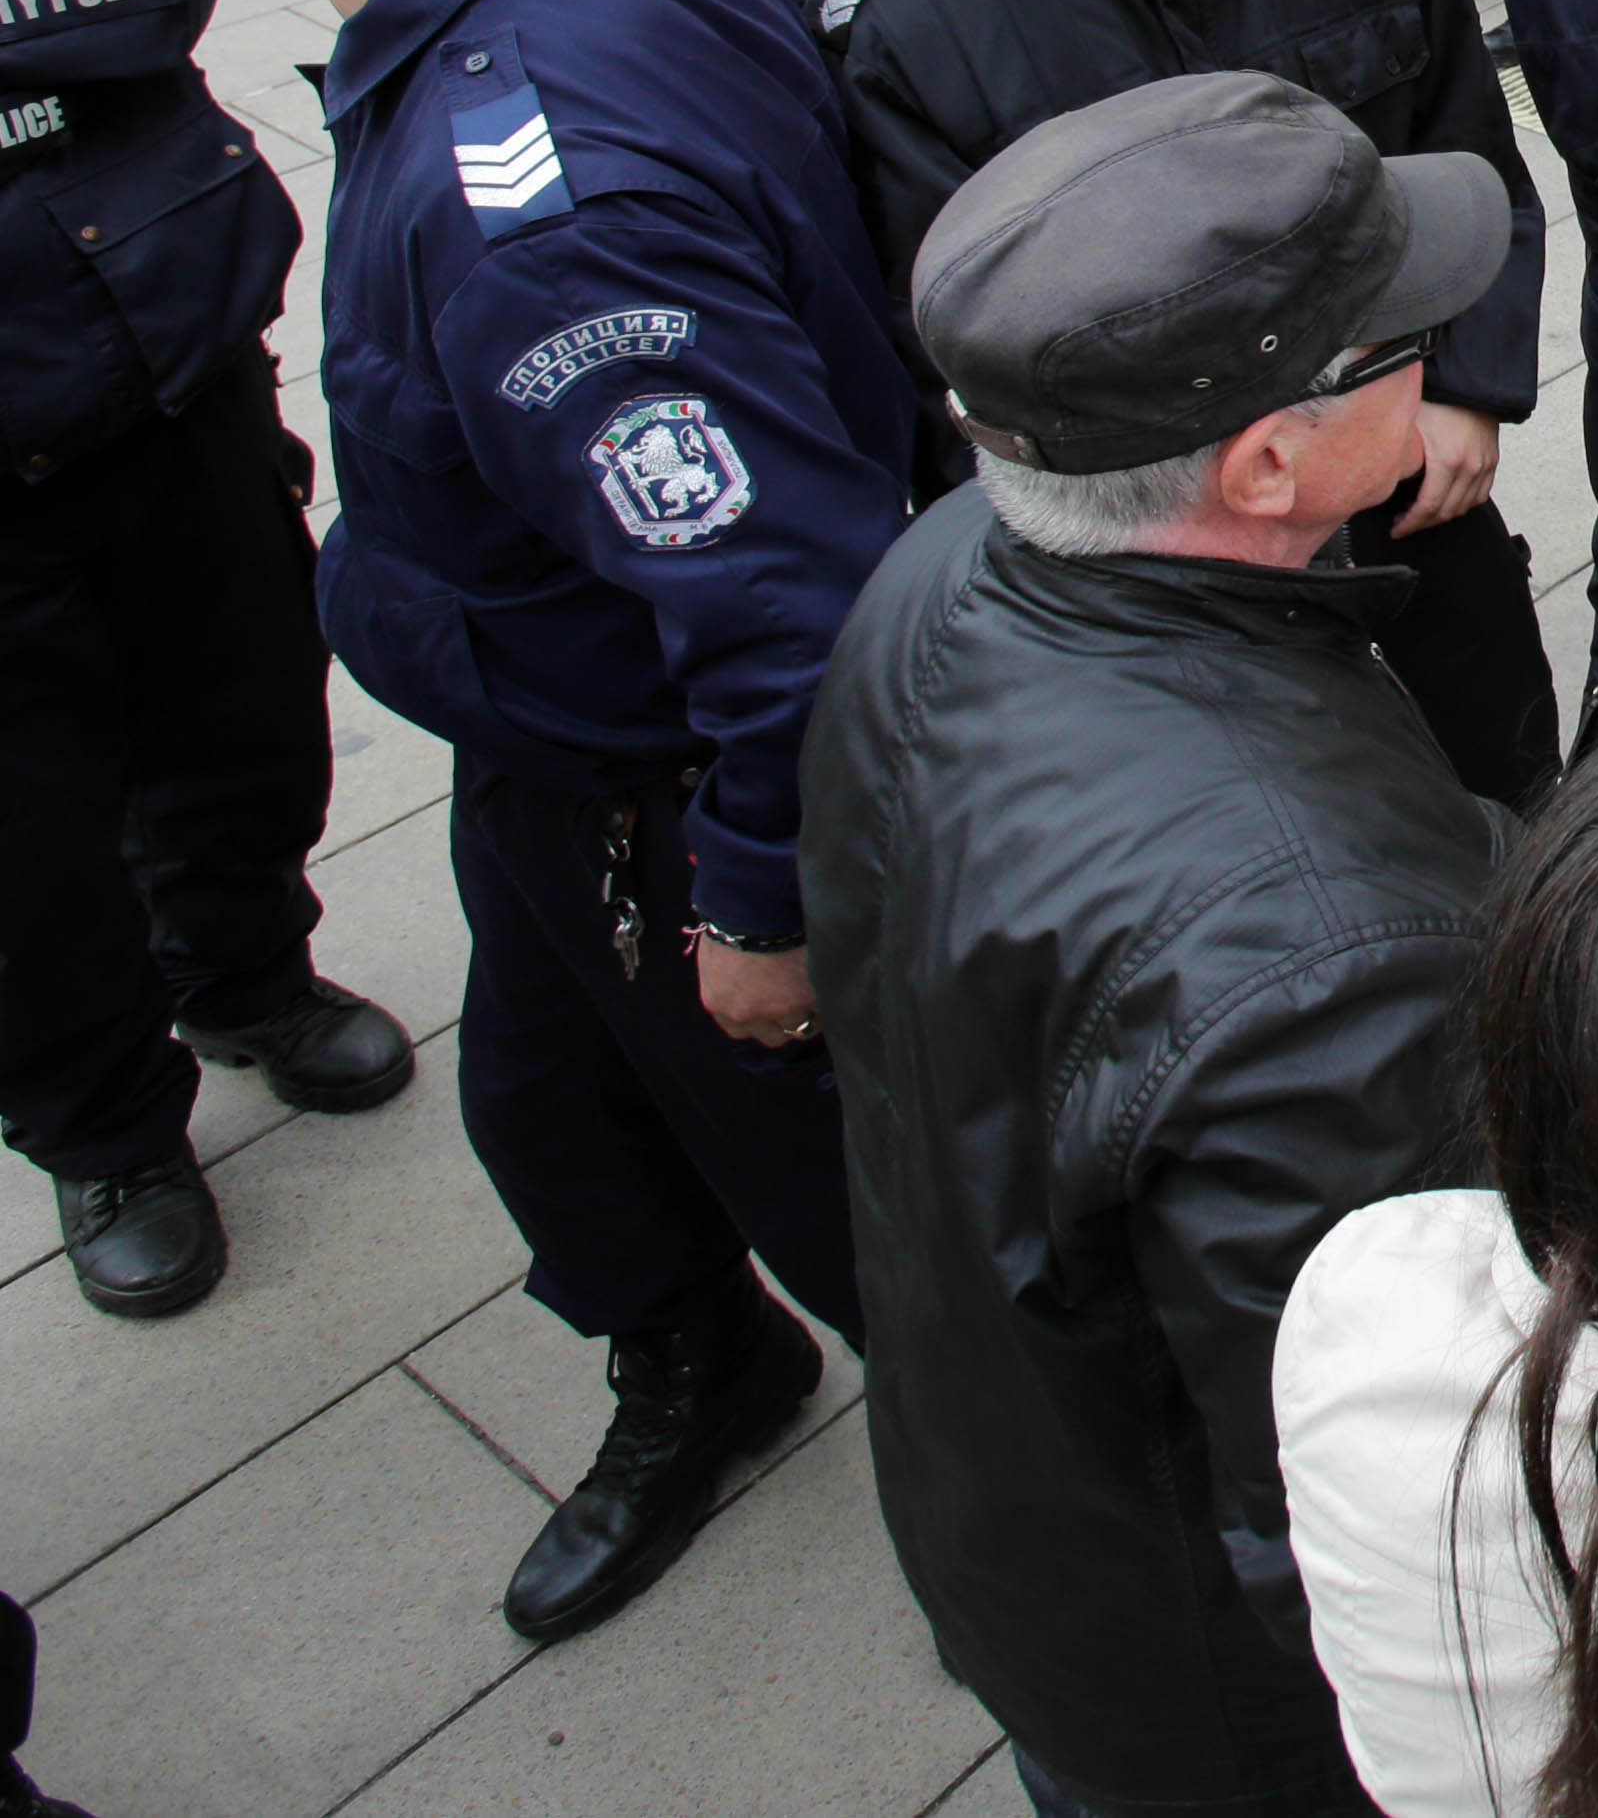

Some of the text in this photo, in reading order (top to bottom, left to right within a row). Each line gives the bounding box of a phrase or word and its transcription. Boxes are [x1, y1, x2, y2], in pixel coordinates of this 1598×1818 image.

[0, 95, 66, 149] LICE
[514, 315, 668, 385] ПОЛИЦИЯ
[541, 337, 653, 389] POLICE
